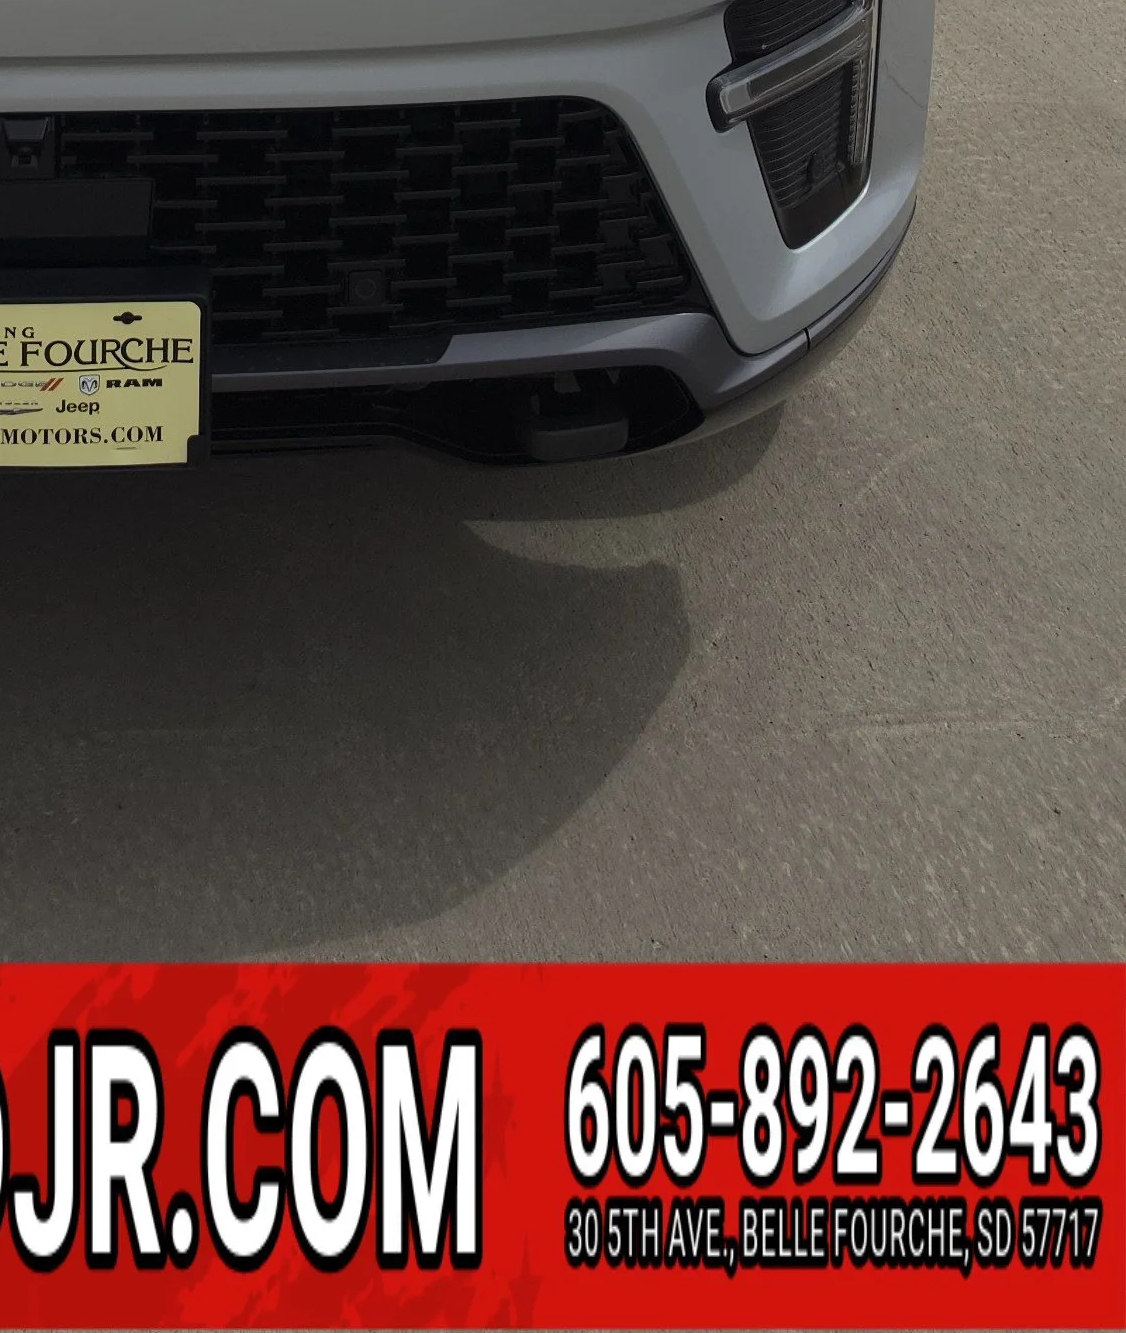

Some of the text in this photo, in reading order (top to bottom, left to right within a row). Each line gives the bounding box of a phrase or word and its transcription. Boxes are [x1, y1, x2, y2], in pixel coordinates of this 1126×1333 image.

[20, 337, 194, 370] FOURCHE
[106, 378, 163, 389] RAM
[55, 399, 100, 415] Jeep
